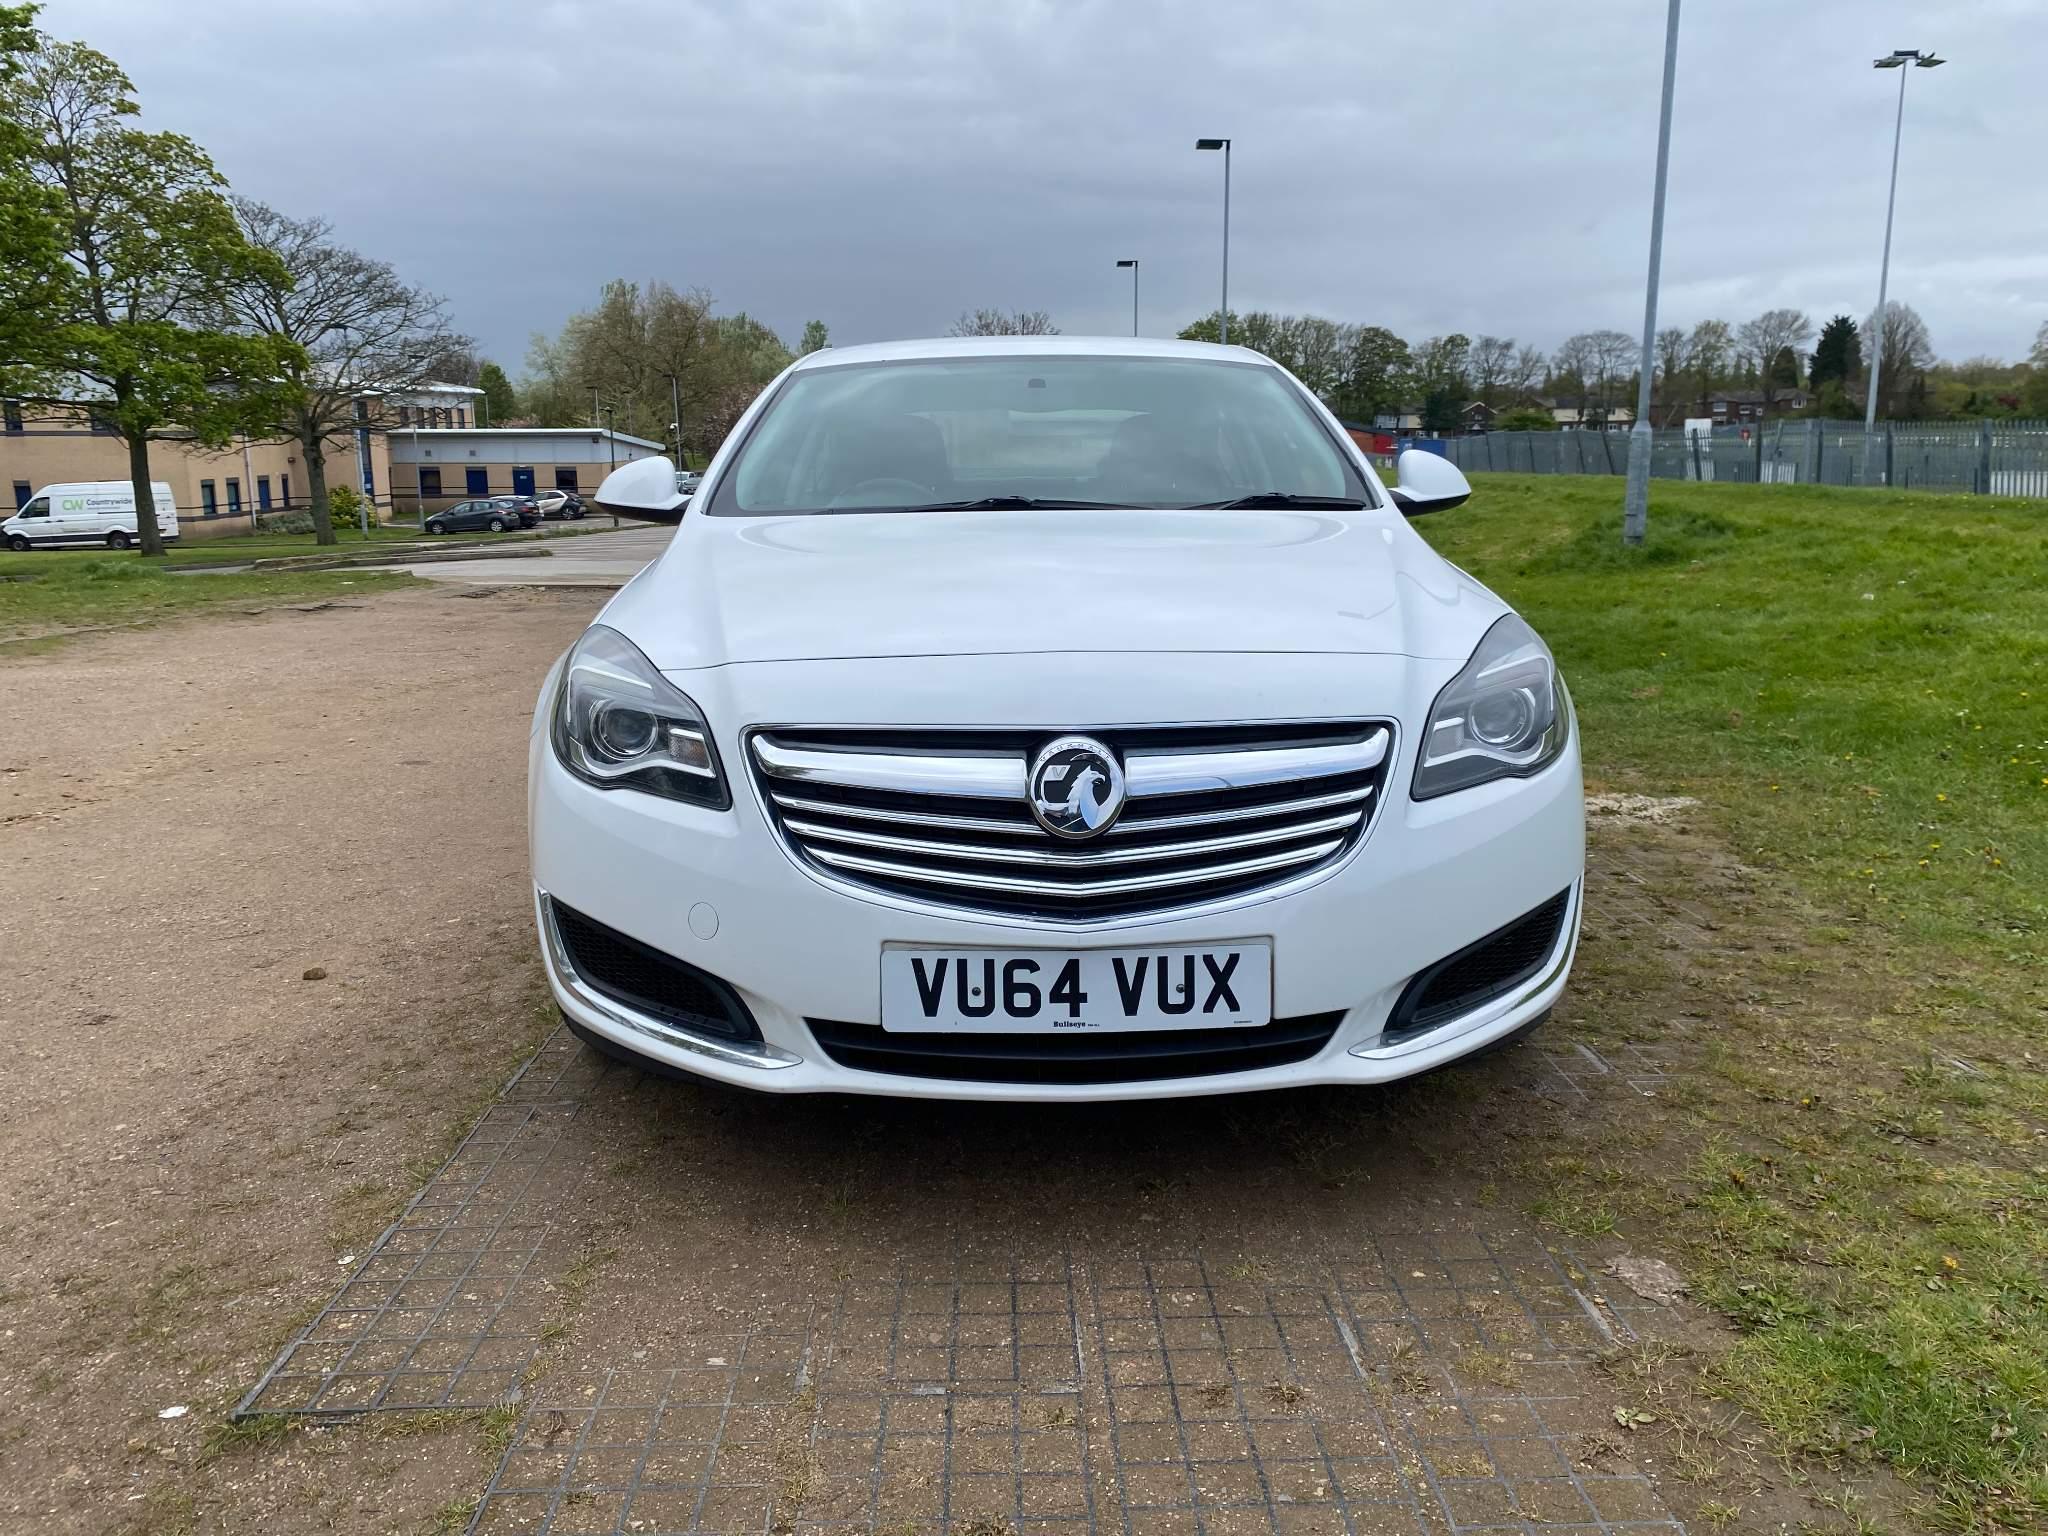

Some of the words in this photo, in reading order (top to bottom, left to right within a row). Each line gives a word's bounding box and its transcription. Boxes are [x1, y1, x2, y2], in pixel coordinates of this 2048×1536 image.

[63, 499, 83, 510] CW
[86, 498, 132, 506] Countrywide
[1052, 766, 1066, 778] V
[911, 957, 1088, 1018] VU64
[1112, 952, 1241, 1017] VUX
